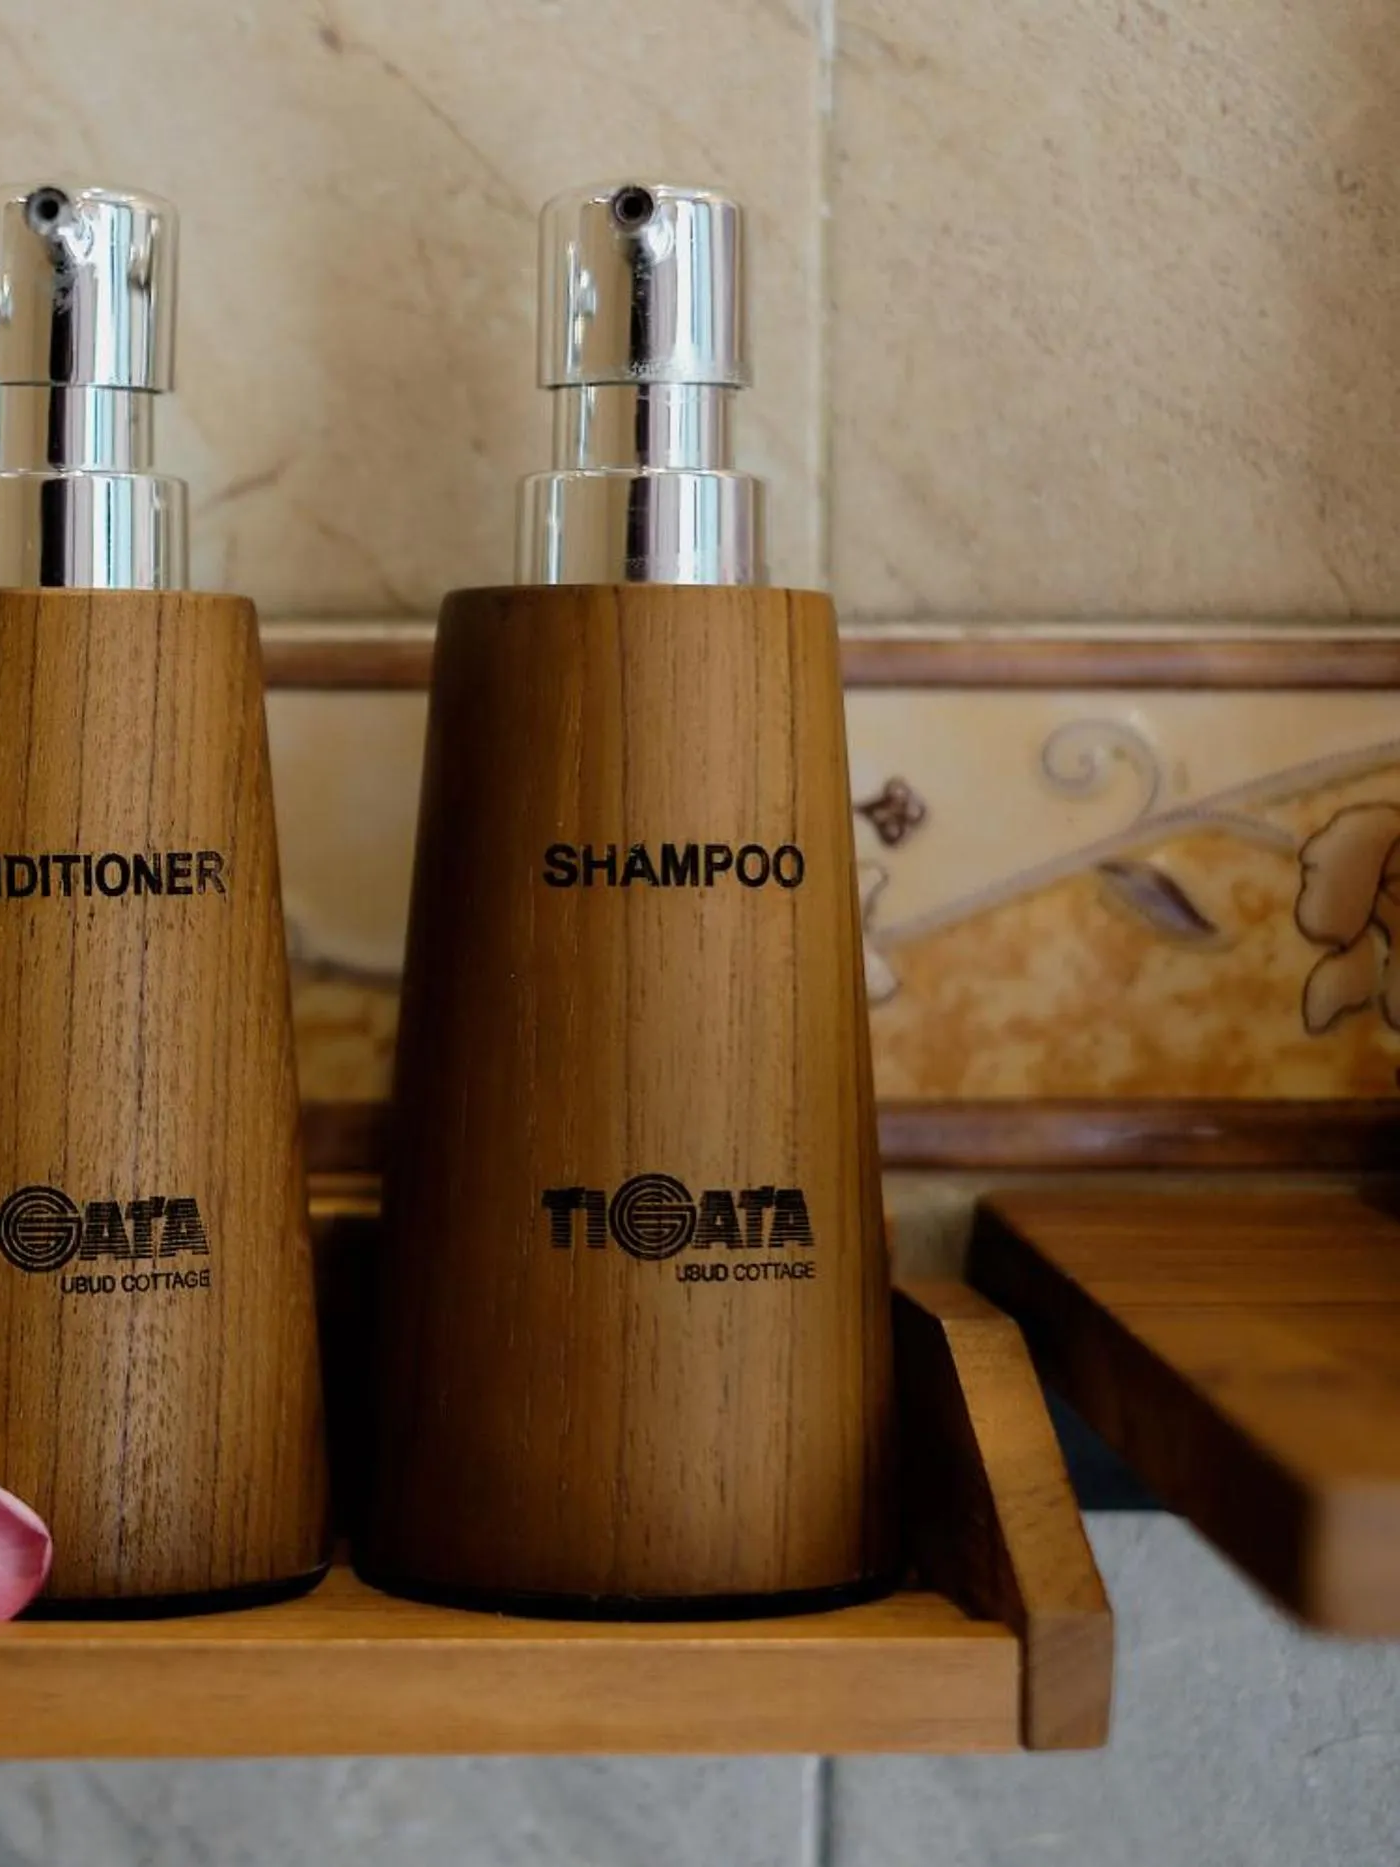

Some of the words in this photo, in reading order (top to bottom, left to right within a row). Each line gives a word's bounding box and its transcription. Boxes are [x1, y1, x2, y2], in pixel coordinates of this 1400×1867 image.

[542, 843, 805, 888] SHAMPOO
[541, 1172, 815, 1261] TIGATA
[60, 1273, 117, 1294] UBUD
[121, 1269, 211, 1292] COTTAGE
[675, 1263, 729, 1282] UBUD
[733, 1261, 816, 1281] COTTAGE
